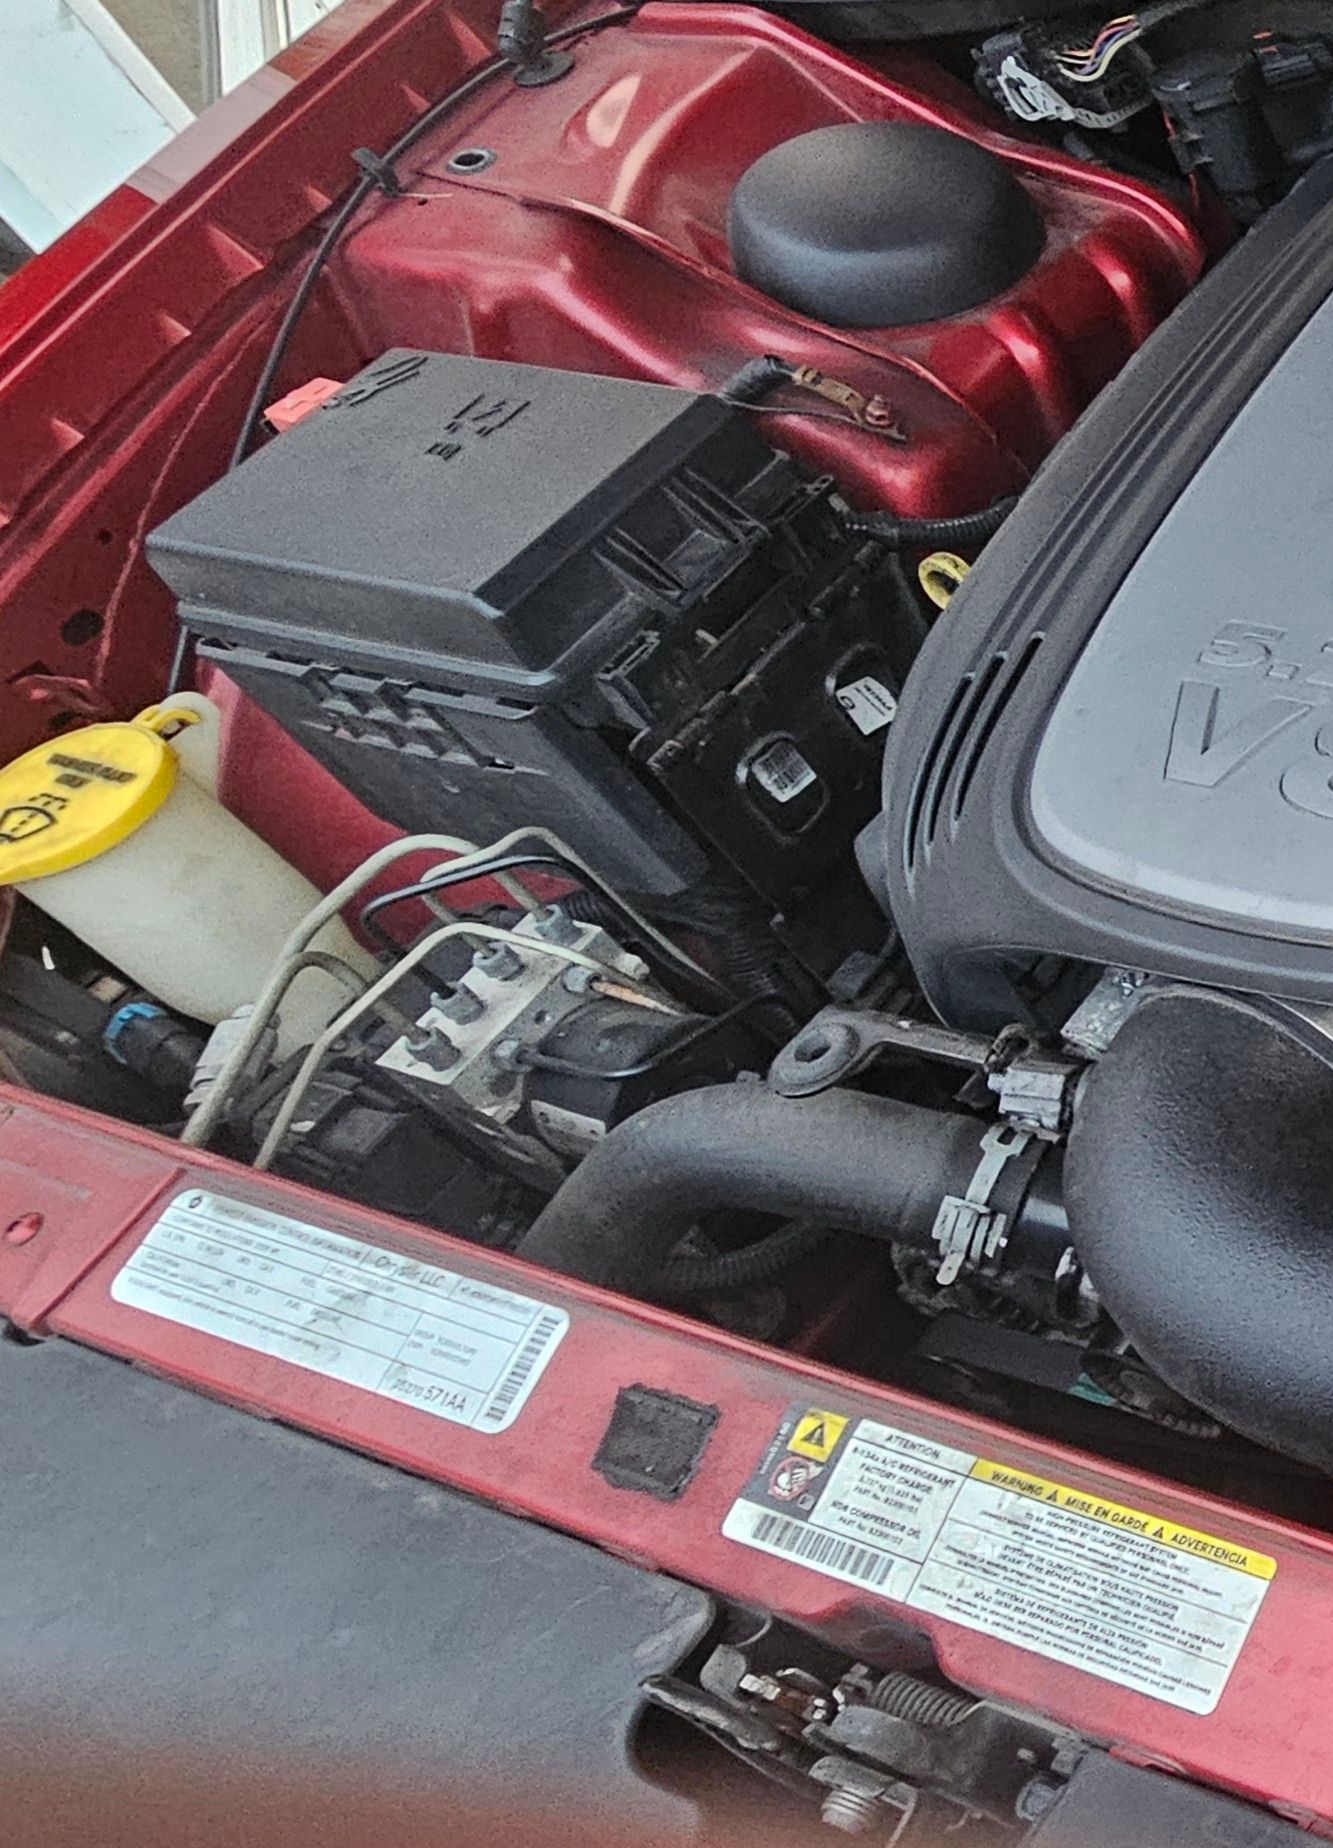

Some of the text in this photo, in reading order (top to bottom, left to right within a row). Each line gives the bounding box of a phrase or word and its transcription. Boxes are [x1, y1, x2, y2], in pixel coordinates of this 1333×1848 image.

[883, 1432, 942, 1460] ATTENTION
[858, 1461, 933, 1494] FACTORY CHARGE
[896, 1462, 956, 1489] REFRIGERANT
[848, 1506, 907, 1533] COMPRESSOR
[988, 1469, 1251, 1567] WARNING MISE EN GARDE ADVERTENCIA
